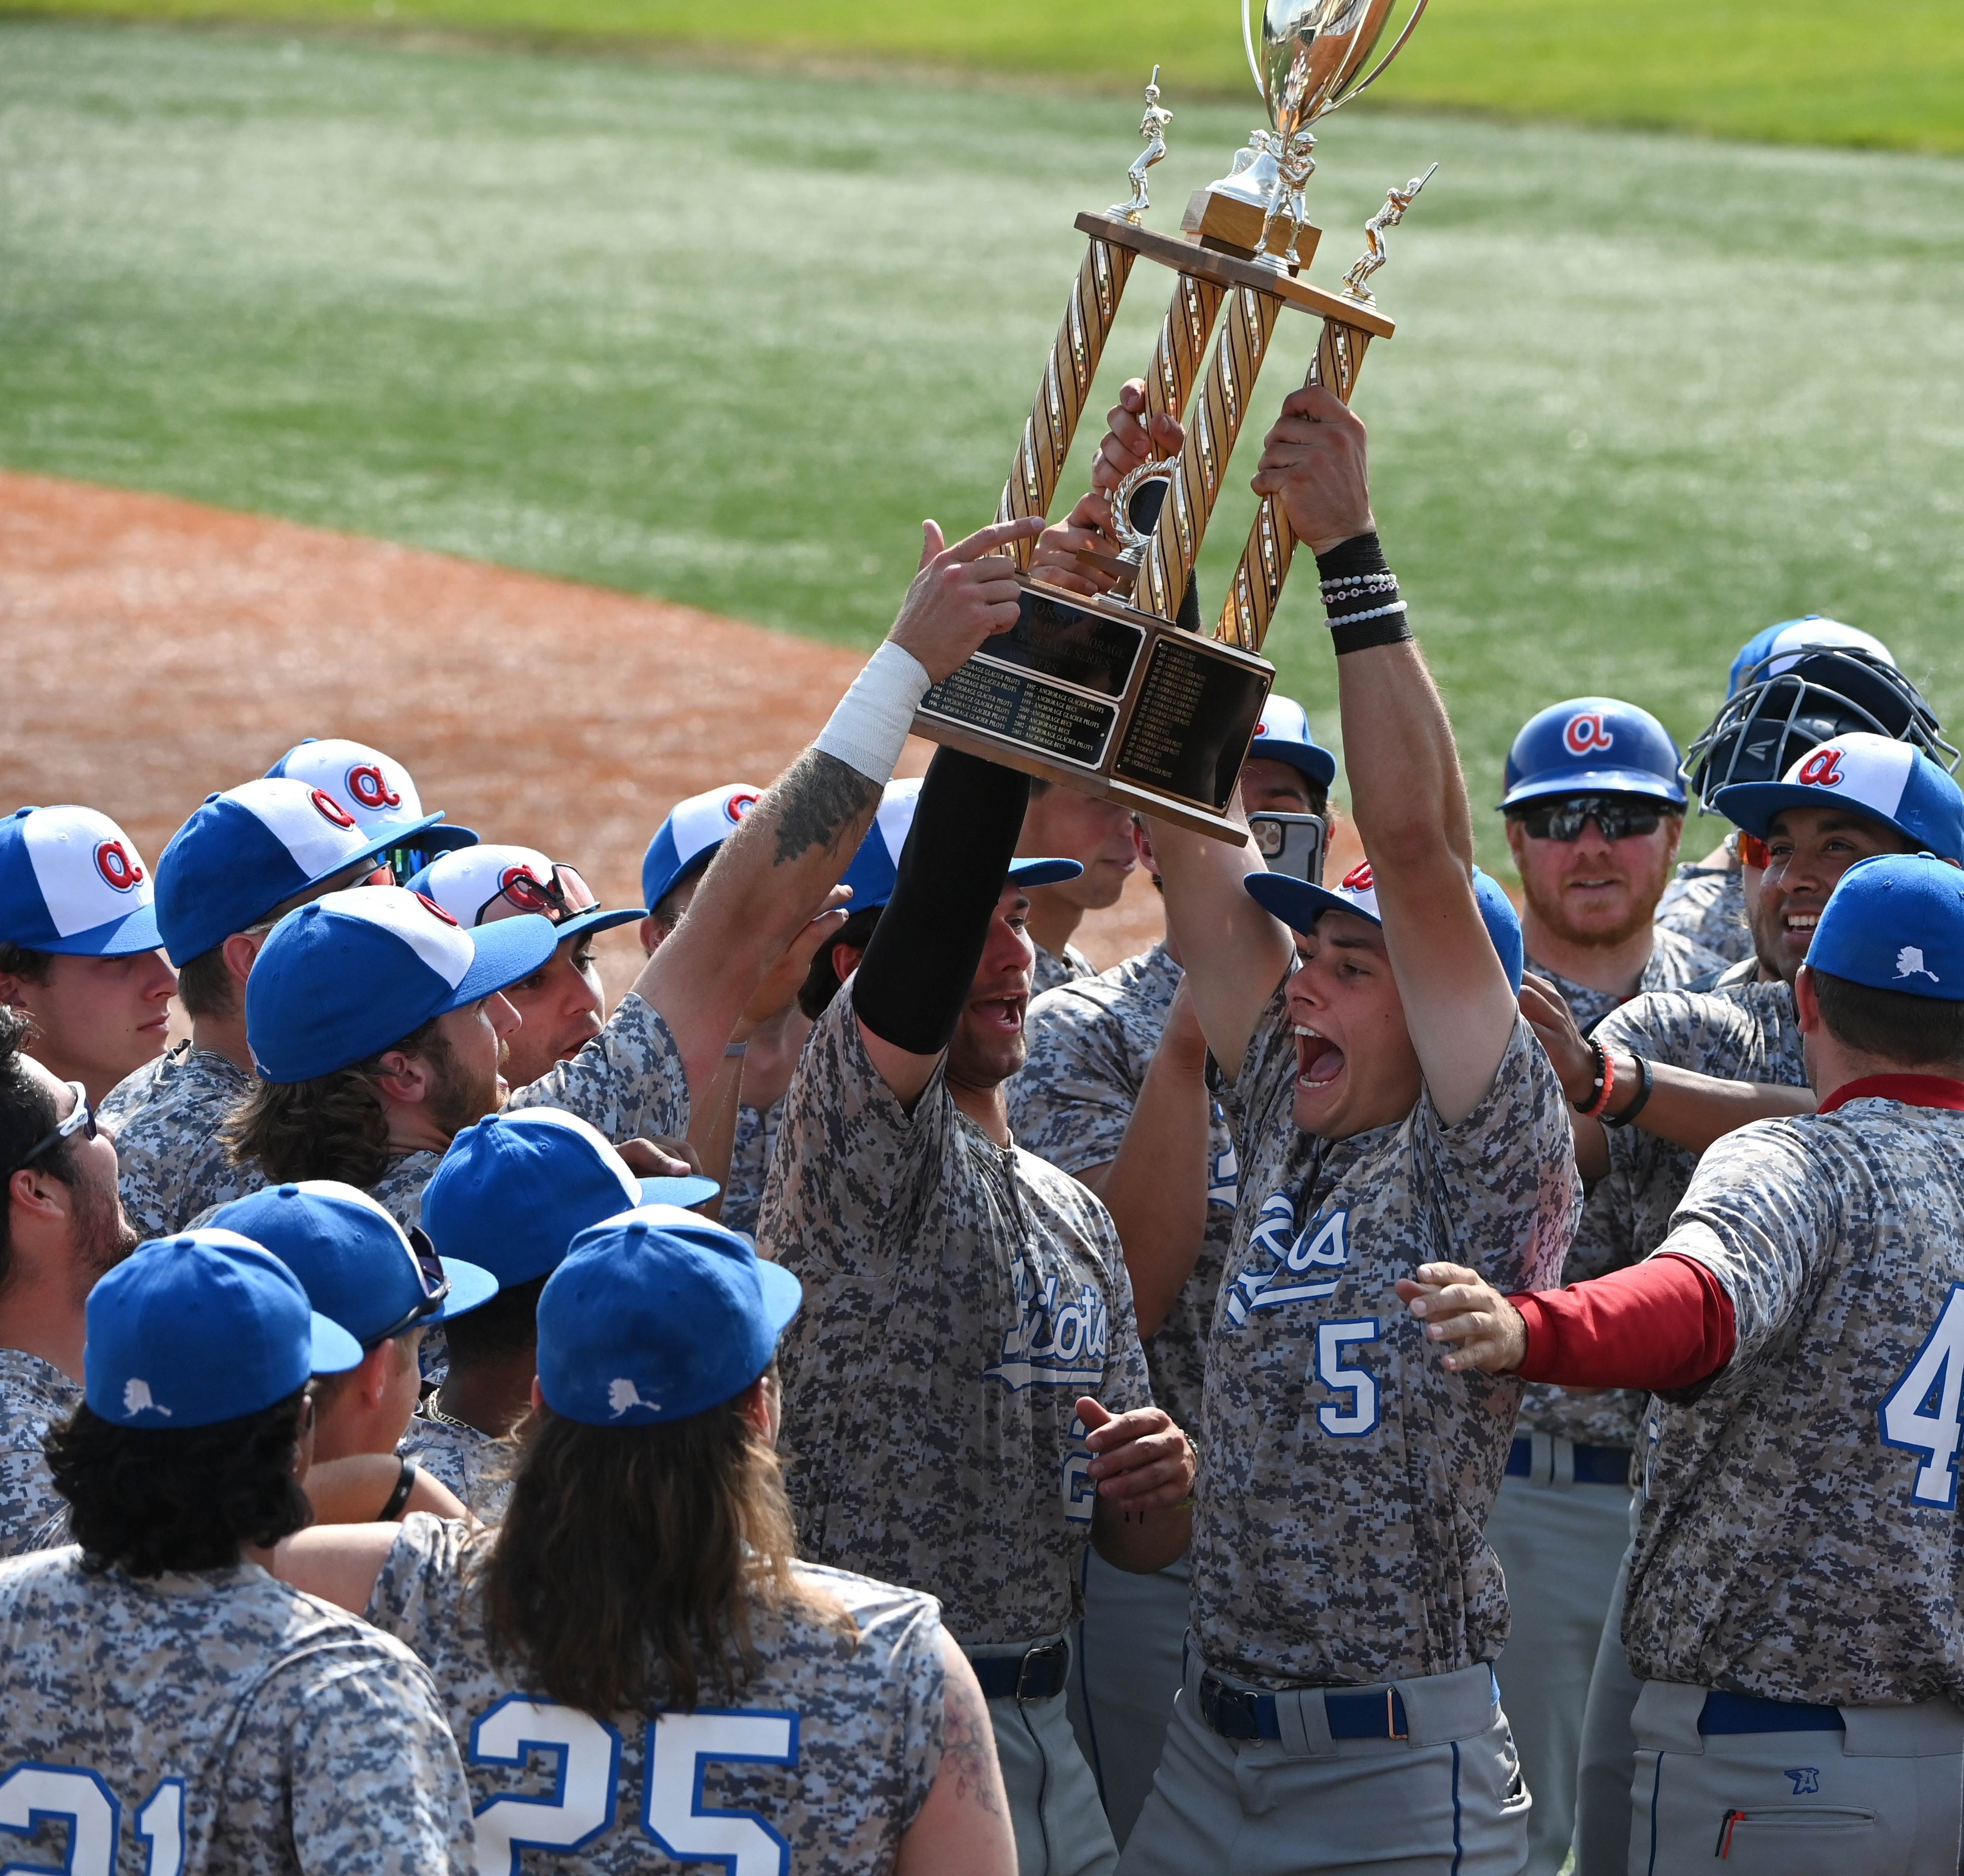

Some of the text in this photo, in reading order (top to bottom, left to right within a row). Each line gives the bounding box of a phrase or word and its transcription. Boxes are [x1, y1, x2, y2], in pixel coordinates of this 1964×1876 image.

[951, 675, 991, 692] ANCHORAGE BUCS
[962, 661, 1021, 686] CHORAGE GLACIER PILOTS
[980, 676, 1001, 687] GLACIER
[1001, 682, 1017, 692] PILOTS
[945, 689, 974, 703] ANCHORAGE
[974, 698, 994, 710] GLACIER
[994, 705, 1010, 715] PILOTS
[948, 682, 976, 695] ANCHORAGE
[976, 691, 996, 702] GLACIER
[996, 697, 1012, 708] PILOTS
[1036, 695, 1065, 709] ANCHORAGE
[1065, 704, 1078, 713] BUCS
[1038, 687, 1067, 701] ANCHORAGE
[1067, 697, 1088, 708] GLACIER
[1088, 704, 1104, 714] PILOTS
[940, 704, 968, 717] ANCHORAGE
[969, 713, 989, 724] GLACIER
[989, 720, 1005, 730] PILOTS
[943, 696, 971, 710] ANCHORAGE
[971, 706, 991, 717] GLACIER
[991, 712, 1007, 722] PILOTS
[1019, 705, 1030, 714] 2000
[1060, 719, 1072, 728] BUCS
[1034, 702, 1062, 716] ANCHORAGE
[1063, 712, 1083, 723] GLACIER
[1083, 719, 1100, 729] PILOTS
[1014, 720, 1024, 728] 2002
[1027, 725, 1056, 739] ANCHORAGE
[1056, 734, 1077, 745] GLACIER
[1077, 741, 1094, 751] PILOTS
[1016, 713, 1026, 721] 2001
[1028, 717, 1057, 731] ANCHORAGE
[1058, 726, 1070, 735] BUCS
[1562, 712, 1614, 757] a
[1024, 732, 1053, 746] ANCHORAGE
[1053, 741, 1066, 750] BUCS
[1797, 746, 1845, 789] a
[345, 763, 403, 811] a
[93, 837, 145, 894] a
[1316, 1317, 1381, 1438] 5
